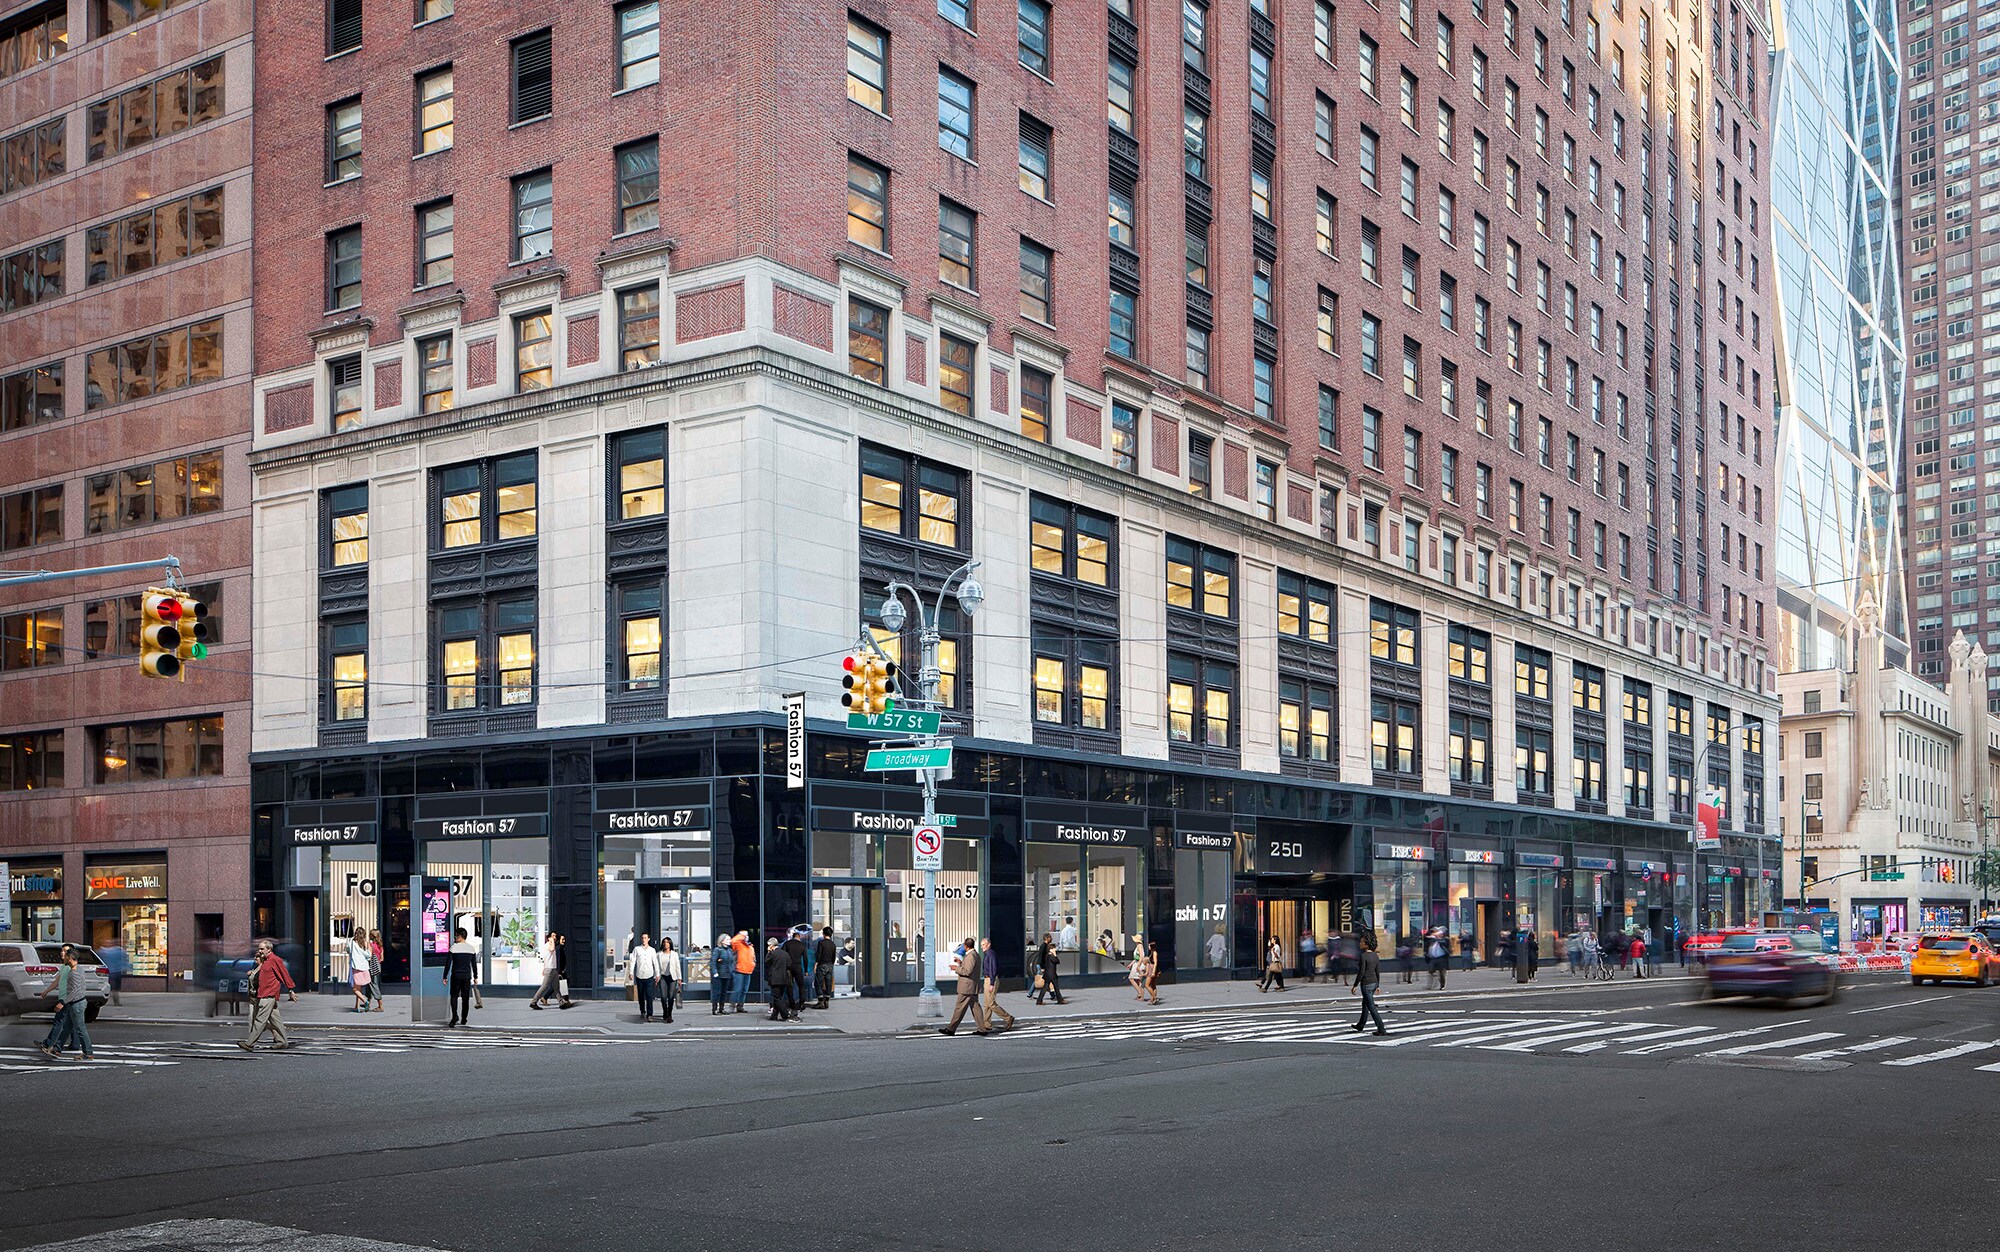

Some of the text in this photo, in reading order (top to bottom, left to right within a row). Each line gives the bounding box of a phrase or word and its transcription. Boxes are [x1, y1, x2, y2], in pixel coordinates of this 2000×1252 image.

[866, 714, 923, 729] W 57 St
[789, 703, 802, 779] Fashion 57
[884, 753, 930, 766] Broadway
[442, 818, 517, 835] Fashion 57
[610, 810, 693, 829] Fashion 57
[853, 812, 914, 830] Fashion
[294, 826, 359, 842] Fashion 57
[1057, 825, 1127, 842] Fashion 57
[1186, 833, 1232, 847] Fashion 57
[1270, 841, 1302, 858] 250
[9, 874, 54, 893] intshop
[91, 877, 125, 889] GNC
[908, 884, 978, 898] Fahion 57
[1175, 904, 1227, 921] ashin 57
[1341, 899, 1352, 933] 250
[891, 952, 904, 962] 57
